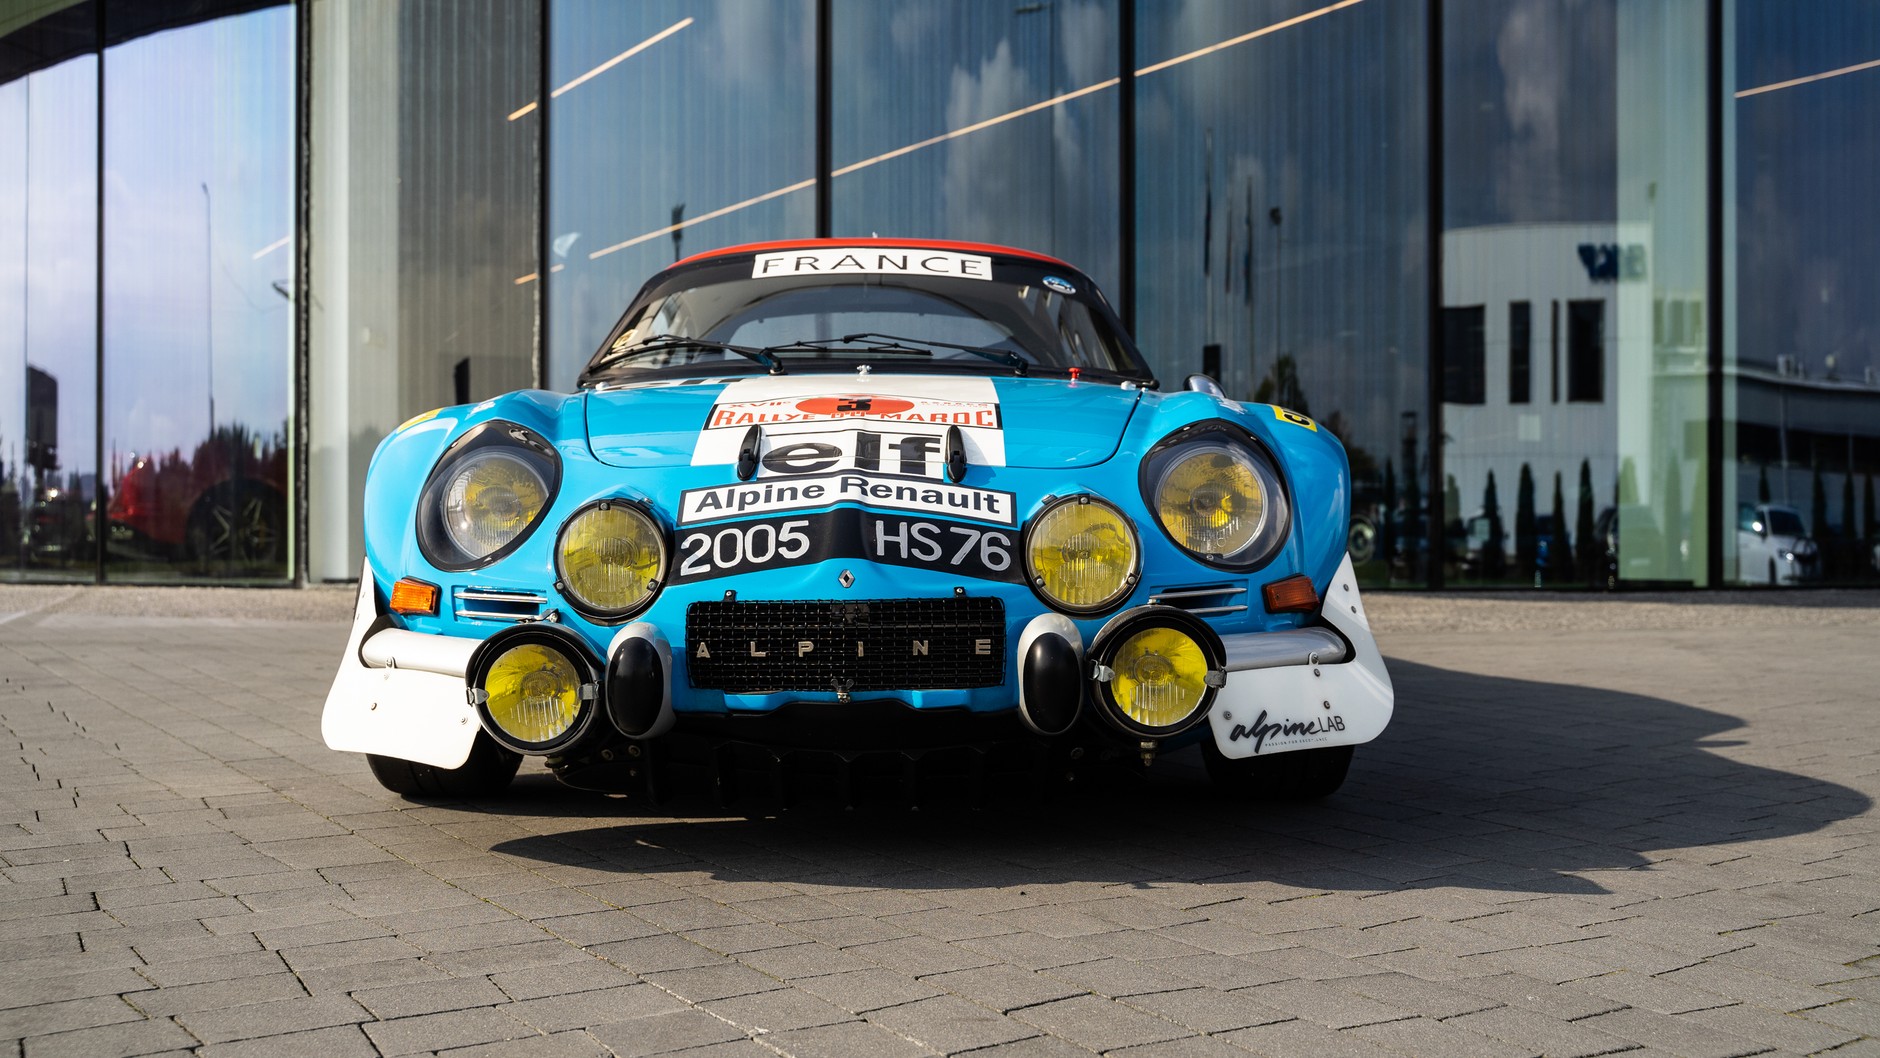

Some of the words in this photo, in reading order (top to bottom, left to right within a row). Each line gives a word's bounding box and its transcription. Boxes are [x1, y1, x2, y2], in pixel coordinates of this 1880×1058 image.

[762, 254, 983, 276] FRANCE
[837, 398, 872, 411] 3
[713, 410, 816, 427] RALLYE
[880, 410, 994, 427] MAROC
[762, 432, 942, 476] elf
[694, 484, 825, 513] Alpine
[840, 476, 1001, 514] Renault
[680, 520, 810, 576] 2005
[696, 638, 992, 659] ALPINE
